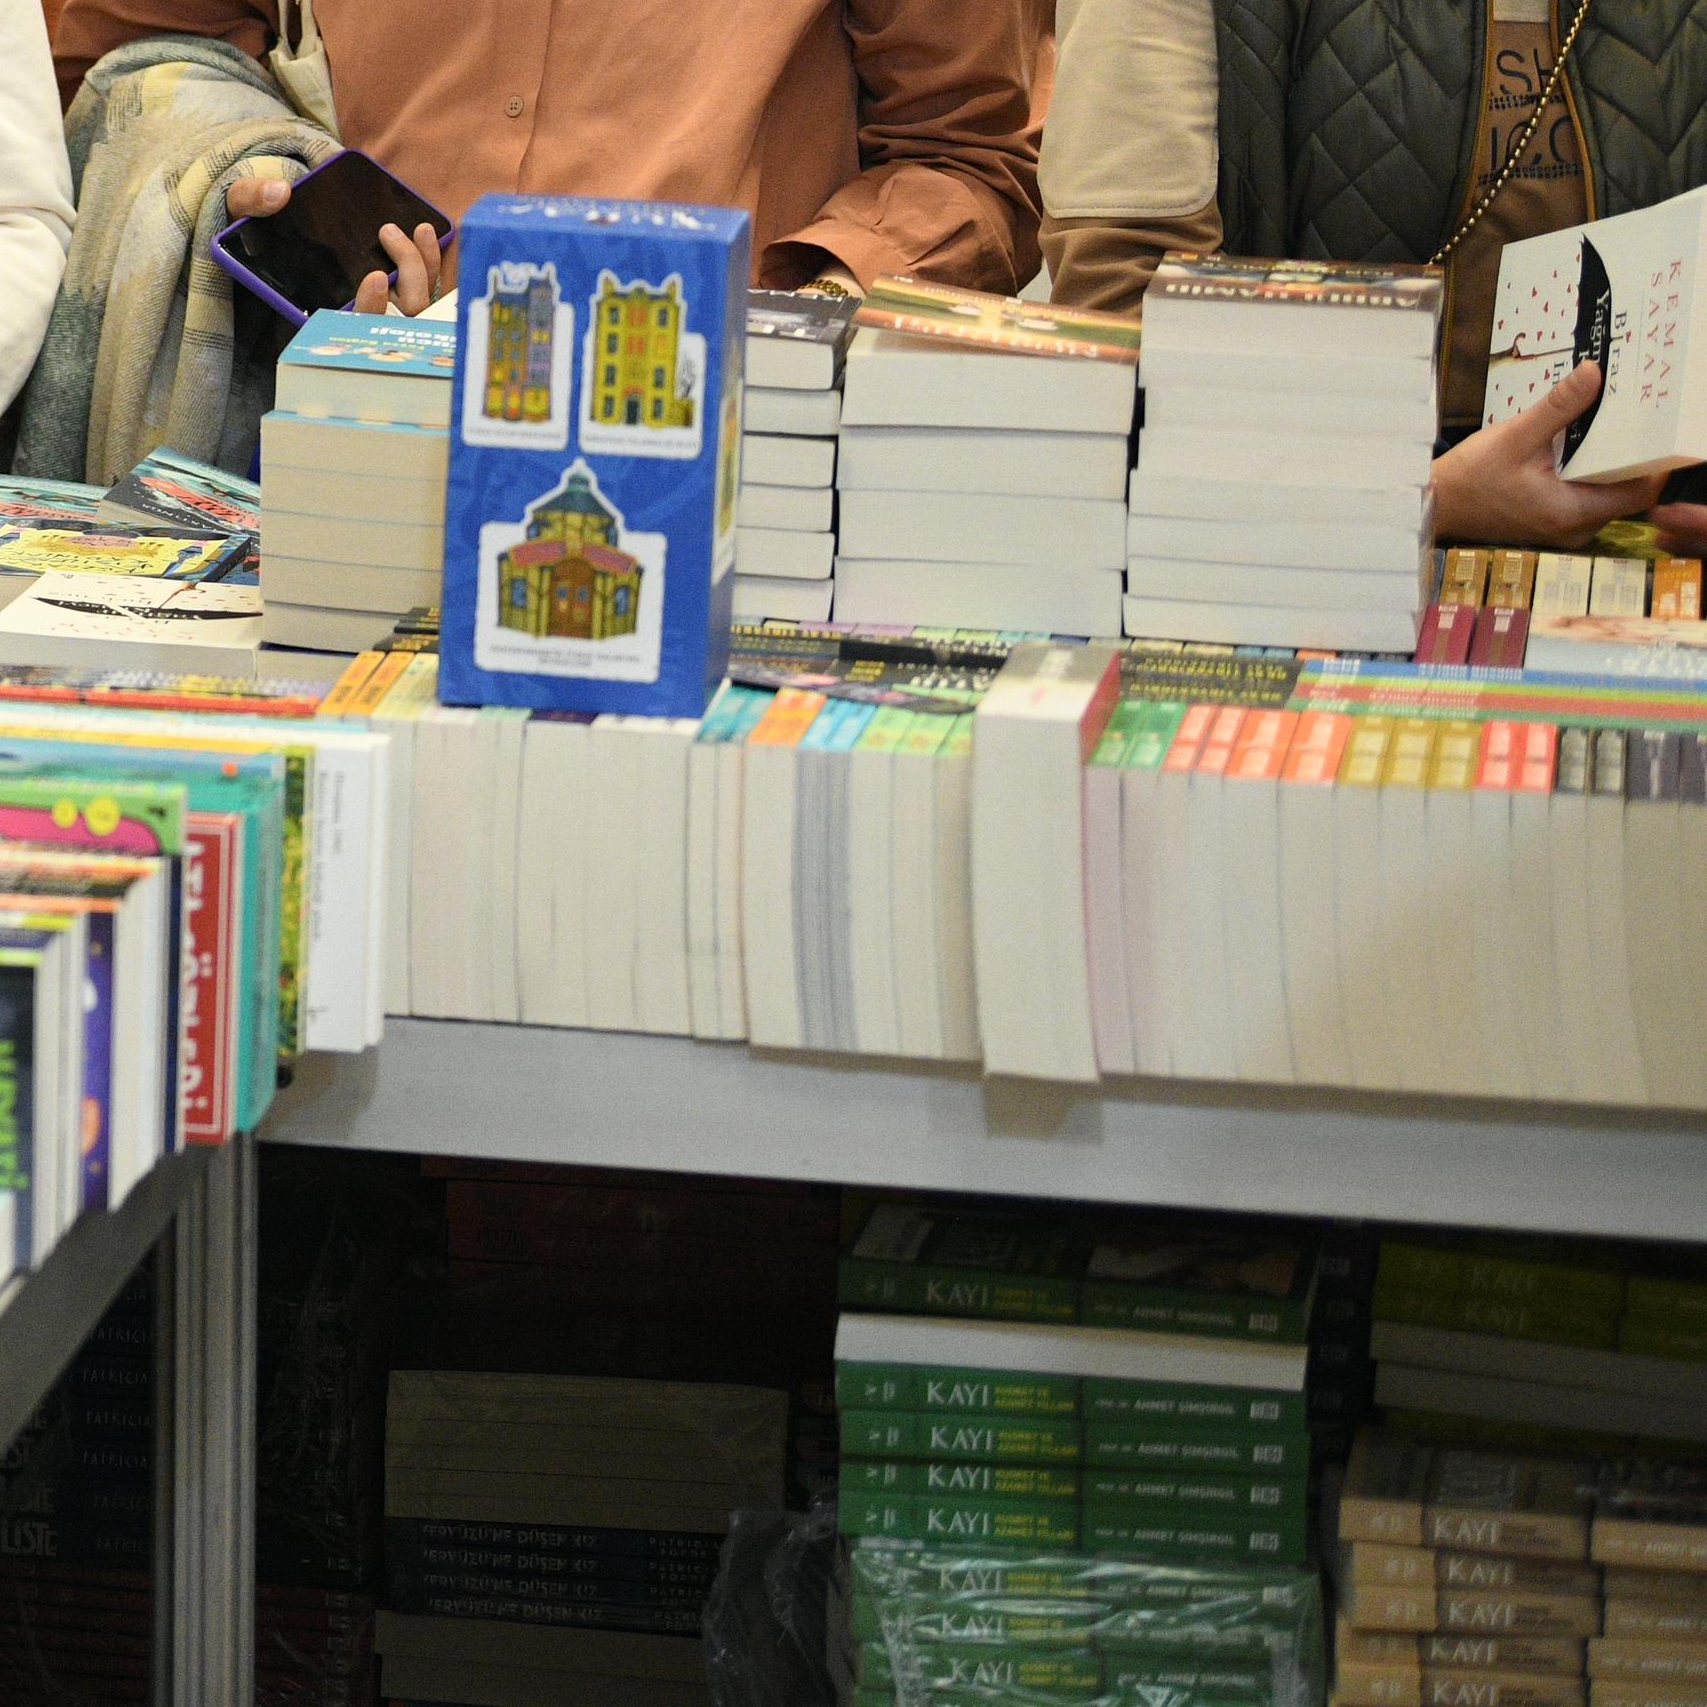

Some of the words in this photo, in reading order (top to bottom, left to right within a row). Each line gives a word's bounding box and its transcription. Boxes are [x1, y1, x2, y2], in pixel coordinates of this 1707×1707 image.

[1590, 290, 1612, 363] Yağm
[1639, 272, 1664, 404] SAYAR
[1655, 260, 1682, 408] KEMAL
[1606, 308, 1628, 396] Biraz
[926, 1380, 990, 1408] KAYI
[930, 1425, 993, 1453] KAYI
[927, 1465, 992, 1492] KAYI
[927, 1508, 990, 1535] KAYI
[1433, 1514, 1500, 1544] KAYI
[1448, 1556, 1515, 1584] KAYI
[1448, 1601, 1515, 1627] KAYI
[1429, 1636, 1498, 1663] KAYI
[950, 1658, 1015, 1685] KAYI
